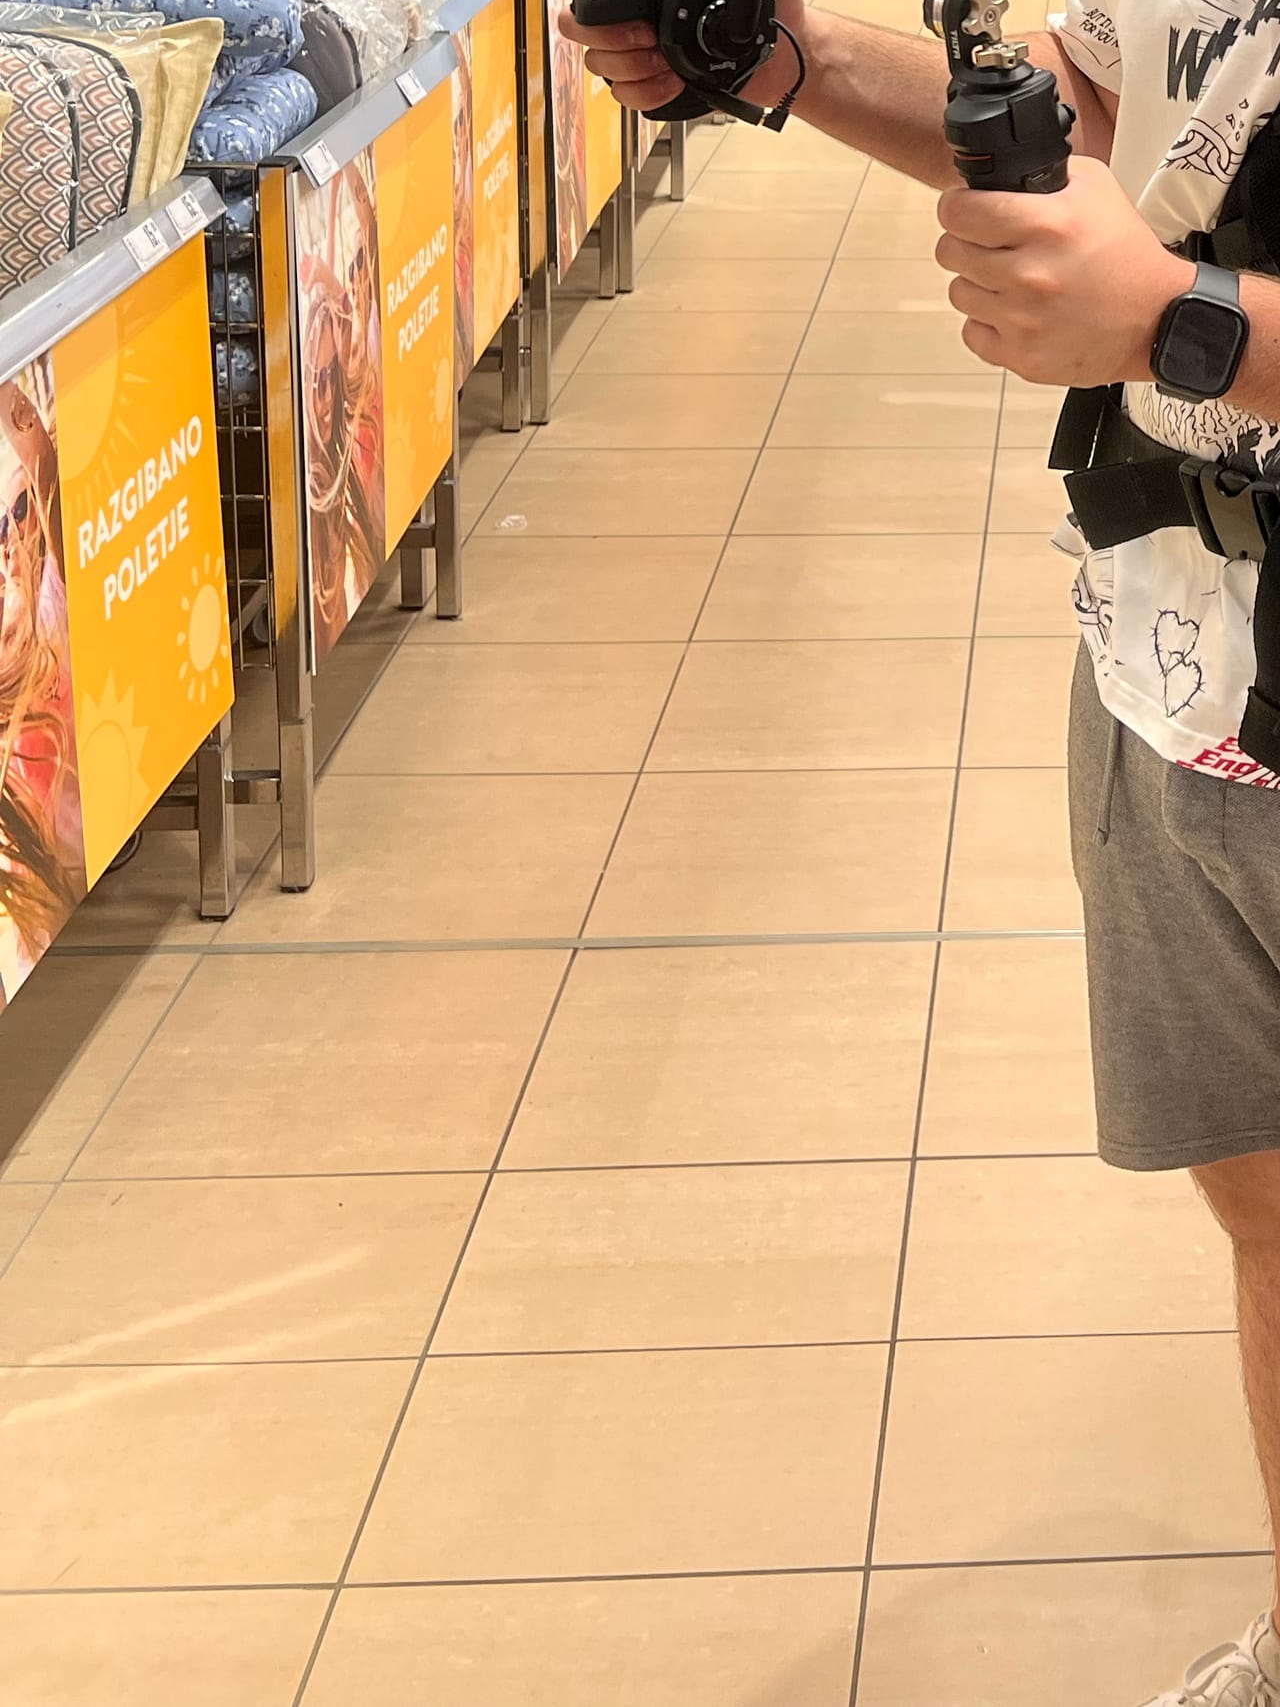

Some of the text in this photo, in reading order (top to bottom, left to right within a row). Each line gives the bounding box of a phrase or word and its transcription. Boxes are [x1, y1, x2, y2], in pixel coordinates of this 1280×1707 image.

[1079, 18, 1097, 35] FOR
[1093, 28, 1115, 45] YOU
[476, 101, 513, 168] RAZGIBANO
[482, 150, 510, 206] POLETJE
[387, 222, 448, 318] RAZGIBANO
[397, 283, 440, 363] POLETJE
[77, 414, 203, 570] RAZGIBANO
[103, 495, 190, 622] POLETJE
